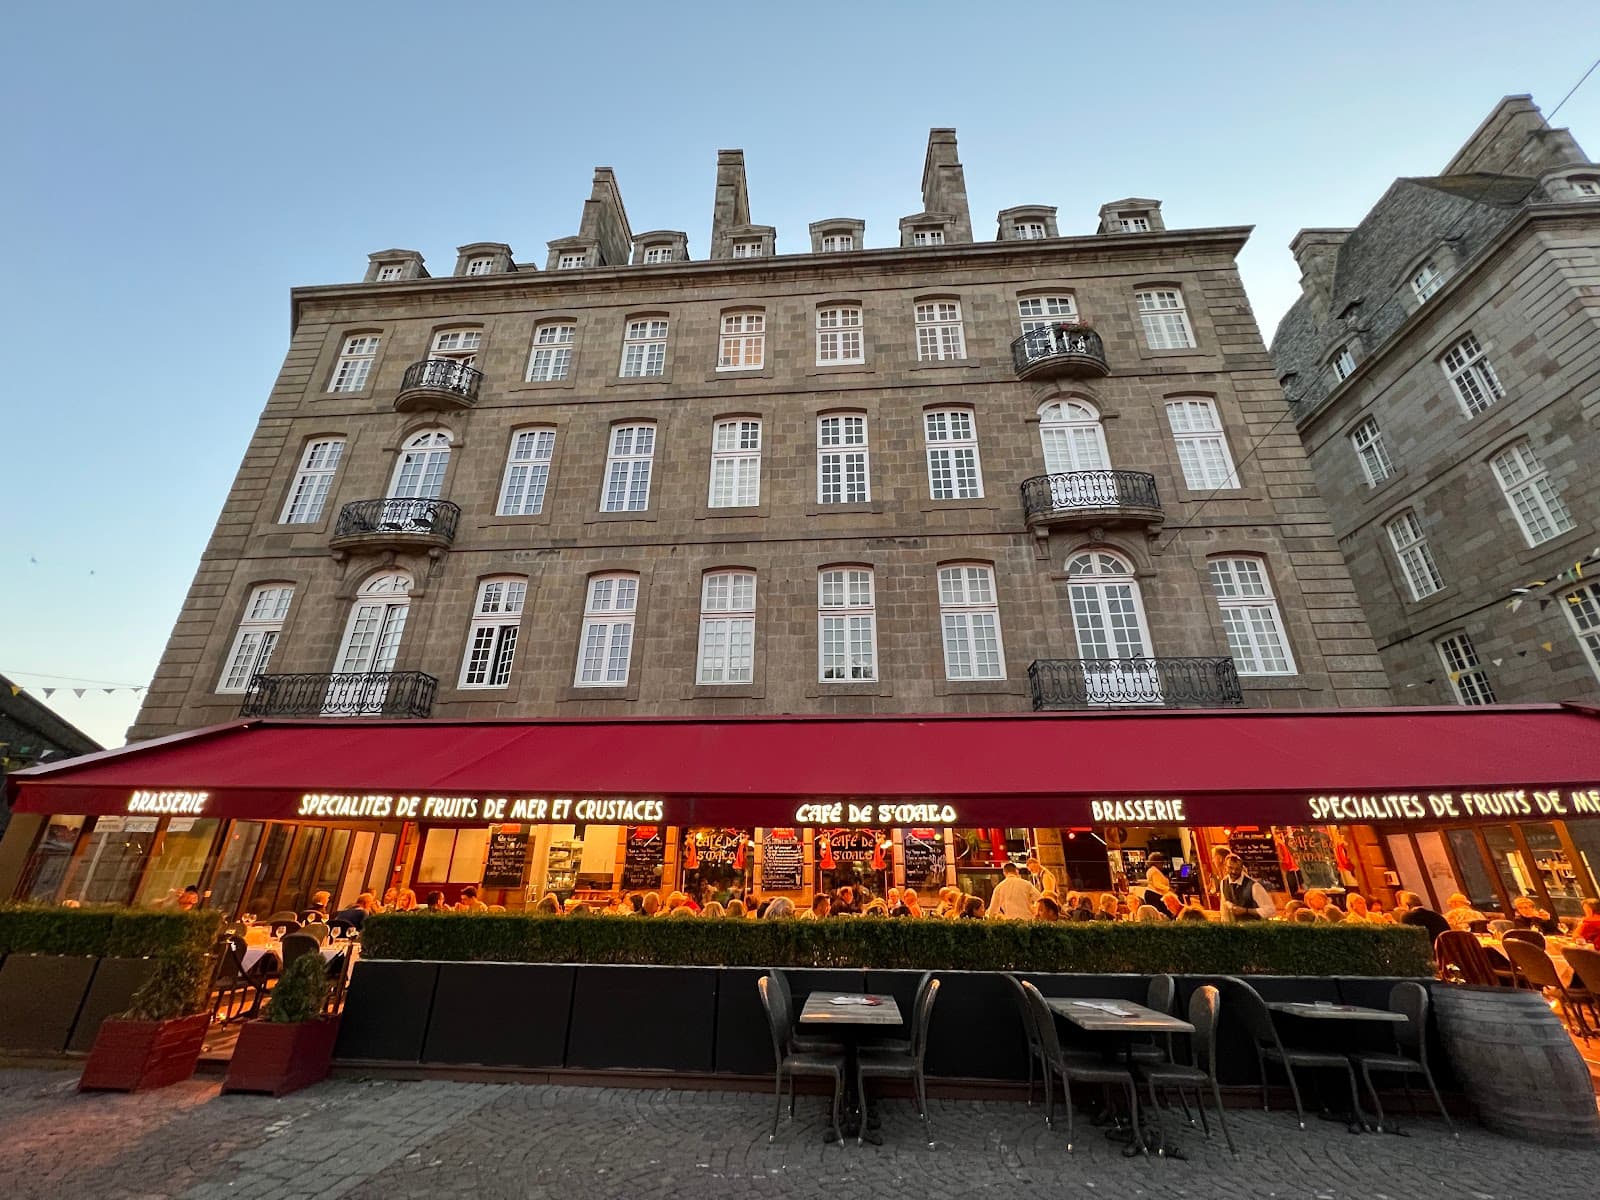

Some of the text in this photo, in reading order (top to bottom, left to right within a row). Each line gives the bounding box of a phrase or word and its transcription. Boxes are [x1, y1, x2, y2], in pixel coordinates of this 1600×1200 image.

[128, 791, 209, 814] BRASSERIE
[298, 794, 663, 821] SPECIALITES DE FRUITS DE MER ET CRUSTACES
[1092, 799, 1186, 821] BRASSERIE
[1309, 795, 1425, 819] SPECIALITES
[1428, 793, 1459, 817] DE
[1461, 790, 1531, 816] FRUITS
[1533, 790, 1567, 814] DE
